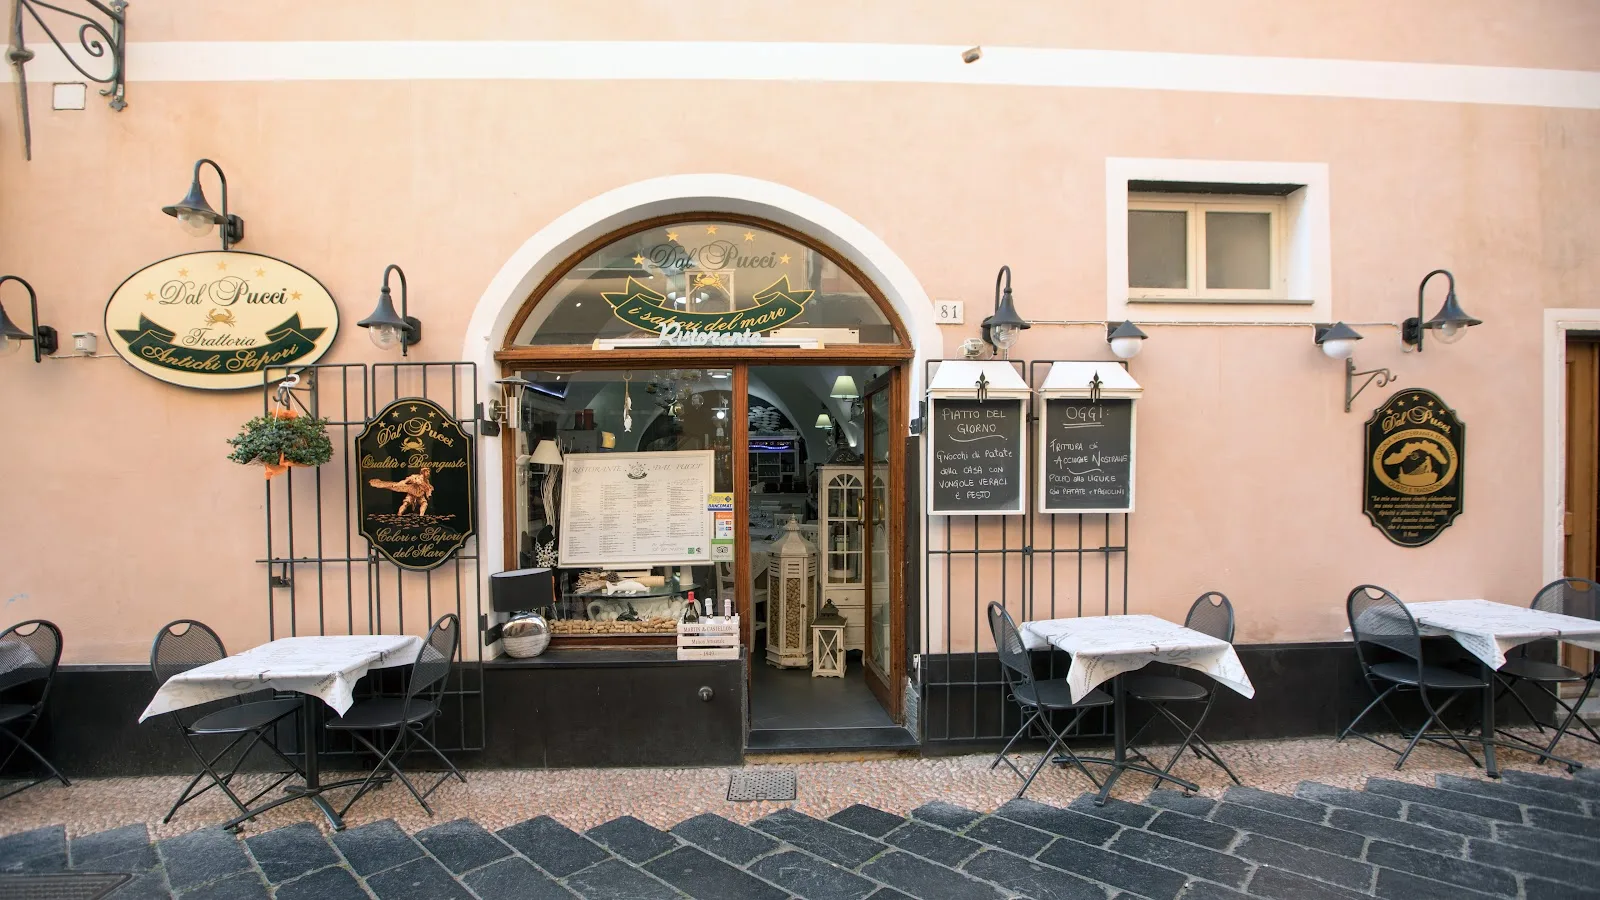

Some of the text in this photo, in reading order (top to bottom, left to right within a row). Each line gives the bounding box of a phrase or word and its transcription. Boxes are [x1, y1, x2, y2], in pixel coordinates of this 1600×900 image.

[648, 239, 777, 270] Dal Pucci
[159, 276, 287, 306] Dal Pucci
[628, 305, 641, 314] i
[704, 312, 744, 331] del
[740, 307, 786, 329] mare
[940, 305, 957, 318] 81
[182, 327, 258, 347] Trattoria
[657, 321, 762, 347] Ristorante
[142, 344, 299, 372] Antichi Sapori
[942, 408, 1006, 420] PIATTO DEL
[1382, 406, 1451, 434] Dal Pucci
[377, 417, 453, 448] Dal Pucci
[957, 423, 996, 434] GIORNO
[972, 450, 980, 458] di
[985, 448, 1012, 458] Patate
[361, 454, 399, 469] Qualità
[408, 454, 467, 473] Buongusto
[963, 466, 982, 474] CASA
[939, 478, 1007, 489] VONGOLE VERACI
[967, 491, 990, 499] PESTO
[376, 527, 410, 542] Colori
[419, 527, 461, 545] Sapori
[393, 543, 445, 558] del Mare
